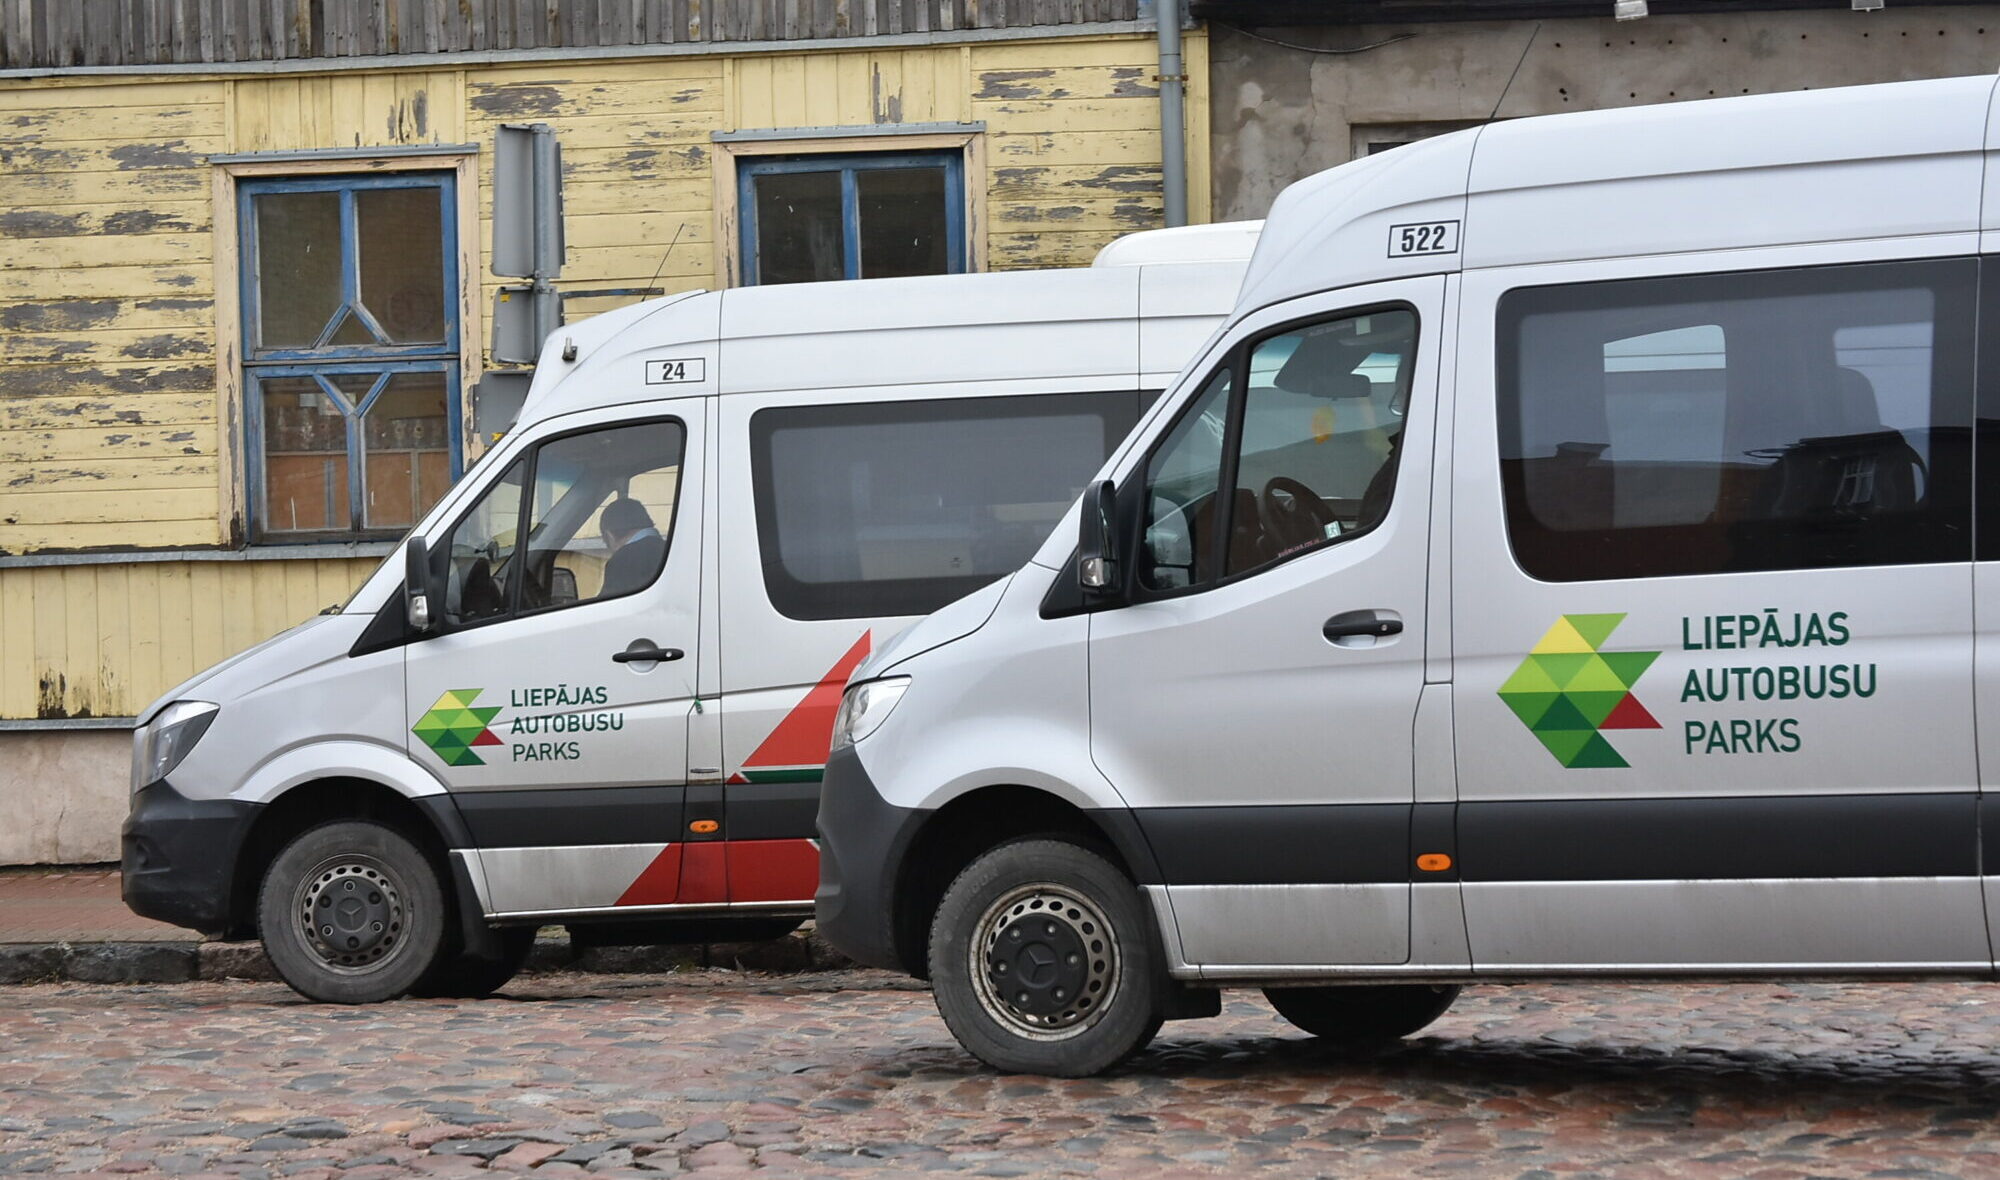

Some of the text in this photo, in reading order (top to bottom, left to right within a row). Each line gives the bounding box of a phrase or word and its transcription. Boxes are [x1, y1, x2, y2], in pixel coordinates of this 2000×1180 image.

[1401, 225, 1446, 252] 522
[662, 362, 686, 380] 24
[1682, 608, 1850, 650] LIEPĀJAS
[511, 684, 608, 707] LIEPĀJAS
[1680, 664, 1877, 703] AUTOBUSU
[510, 713, 623, 734] AUTOBUSU
[1684, 718, 1801, 755] PARKS
[512, 741, 580, 762] PARKS
